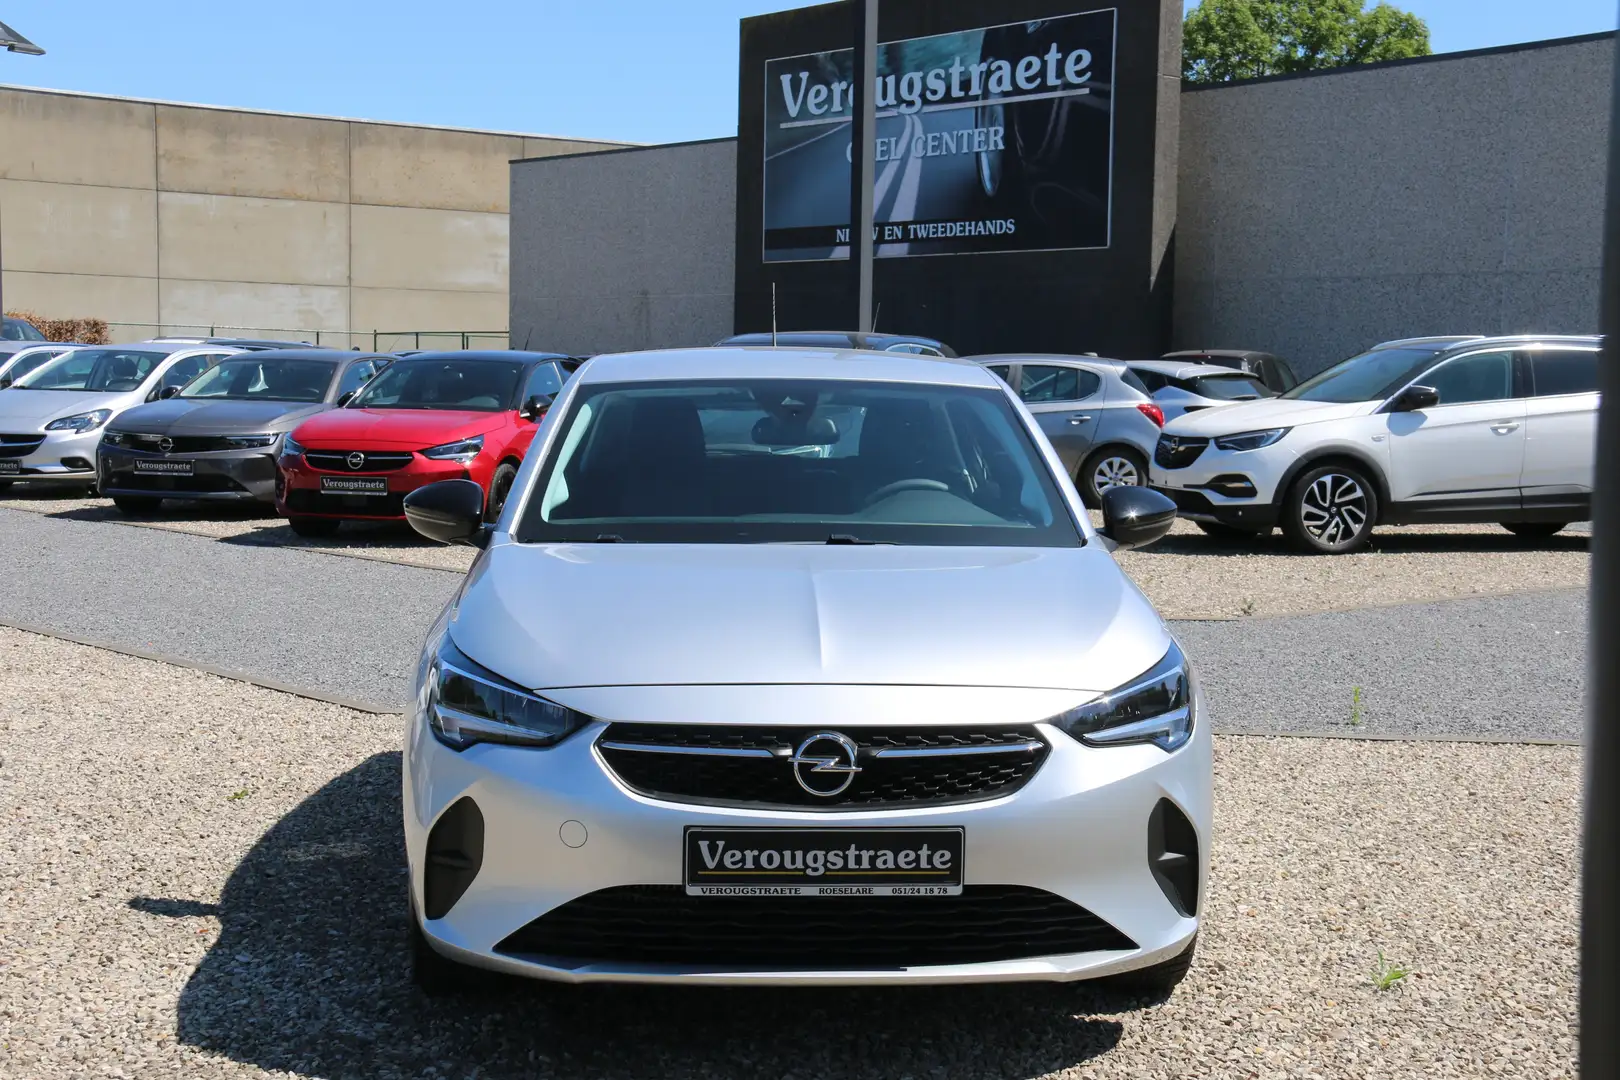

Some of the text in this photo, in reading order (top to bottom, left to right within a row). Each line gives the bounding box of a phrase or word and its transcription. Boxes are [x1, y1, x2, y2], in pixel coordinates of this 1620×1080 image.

[780, 42, 1092, 118] Verugstraete
[846, 126, 1005, 164] EL CENTER
[884, 225, 902, 240] EN
[908, 219, 1015, 239] TWEEDEHANDS
[136, 460, 191, 470] Verougstraete
[323, 478, 385, 489] Verougstraete
[698, 840, 952, 876] Verougstraete
[701, 886, 948, 895] VEROUGSTRAETE ROESELARE 051/24 18 78
